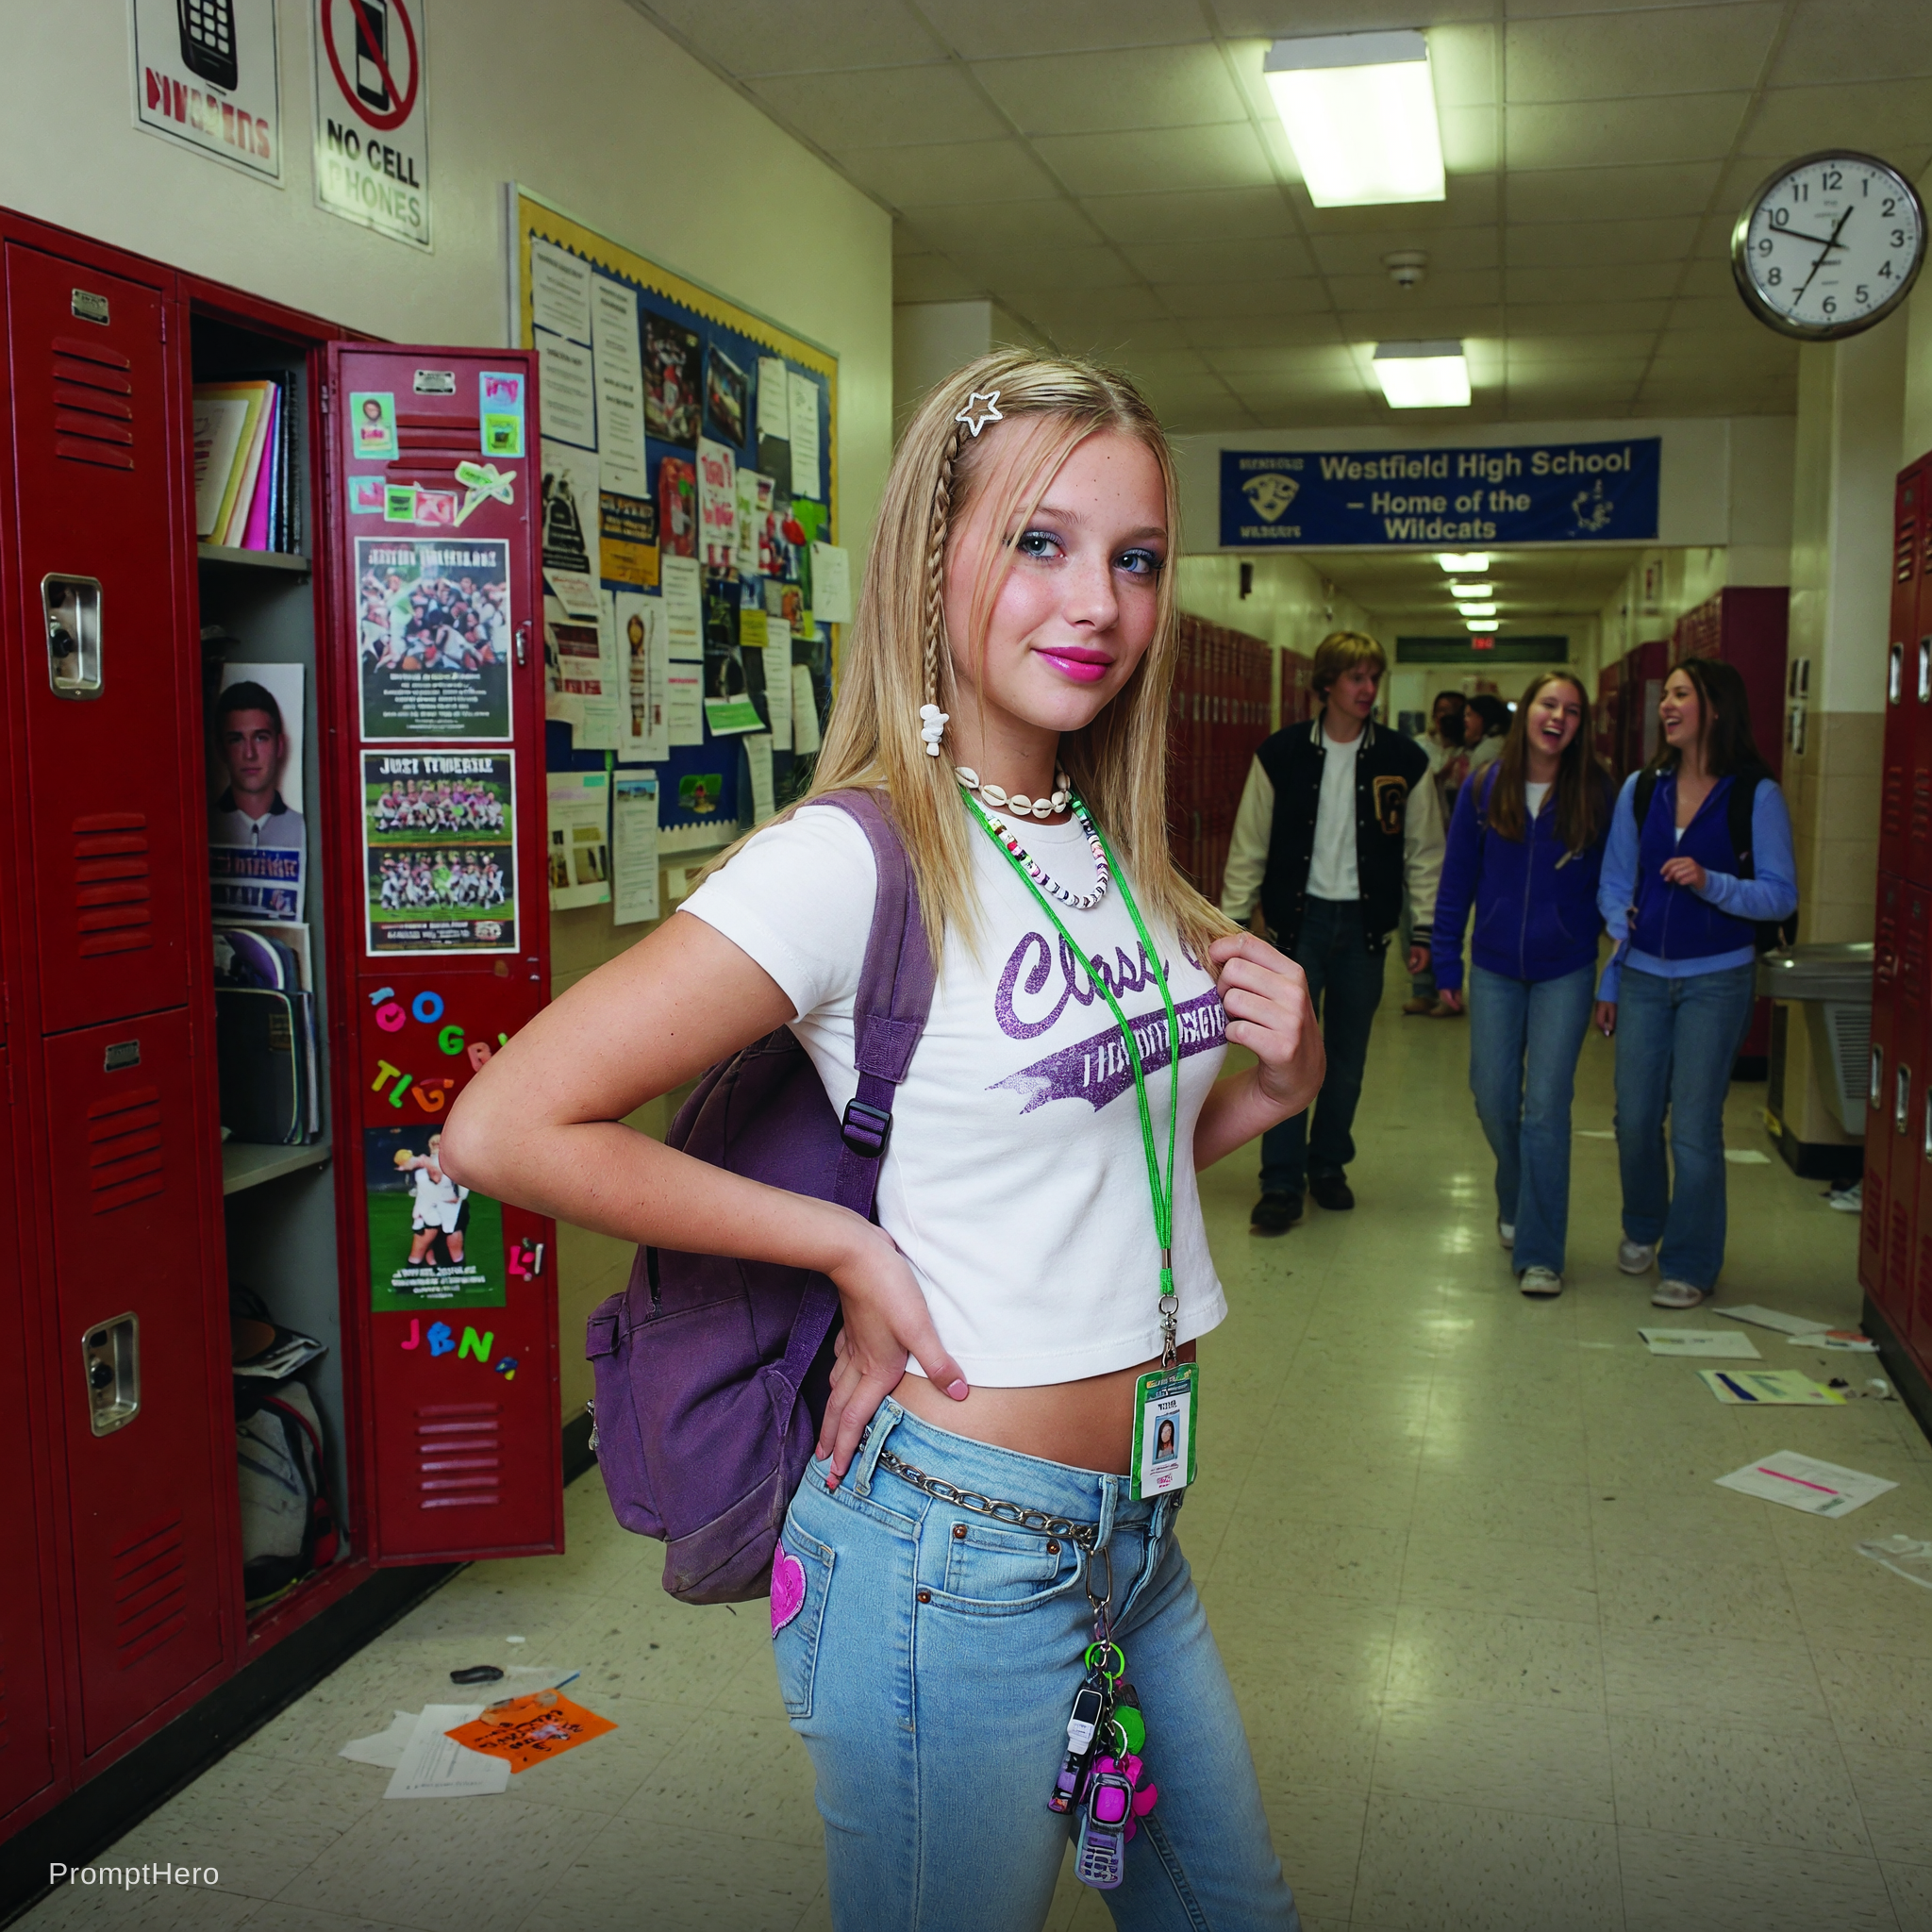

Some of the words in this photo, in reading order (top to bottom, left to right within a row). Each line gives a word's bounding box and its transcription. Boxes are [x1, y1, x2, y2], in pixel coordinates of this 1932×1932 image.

[327, 118, 360, 160] NO
[367, 139, 420, 189] CELL
[1822, 171, 1842, 192] 12
[1861, 178, 1869, 197] 1
[328, 158, 421, 227] PHONES
[1792, 183, 1808, 203] 11
[1881, 198, 1895, 217] 2
[1767, 208, 1790, 228] 10
[1758, 238, 1773, 258] 9
[1890, 229, 1905, 248] 3
[1768, 267, 1782, 287] 8
[1877, 260, 1892, 279] 4
[1791, 288, 1805, 306] 7
[1823, 295, 1837, 314] 6
[1856, 285, 1869, 304] 5
[1321, 454, 1449, 480] Westfield
[1457, 452, 1522, 483] High
[1531, 447, 1631, 475] School
[1372, 491, 1447, 514] Home
[1455, 490, 1484, 513] of
[1489, 489, 1531, 512] the
[1384, 516, 1496, 540] Wildcats
